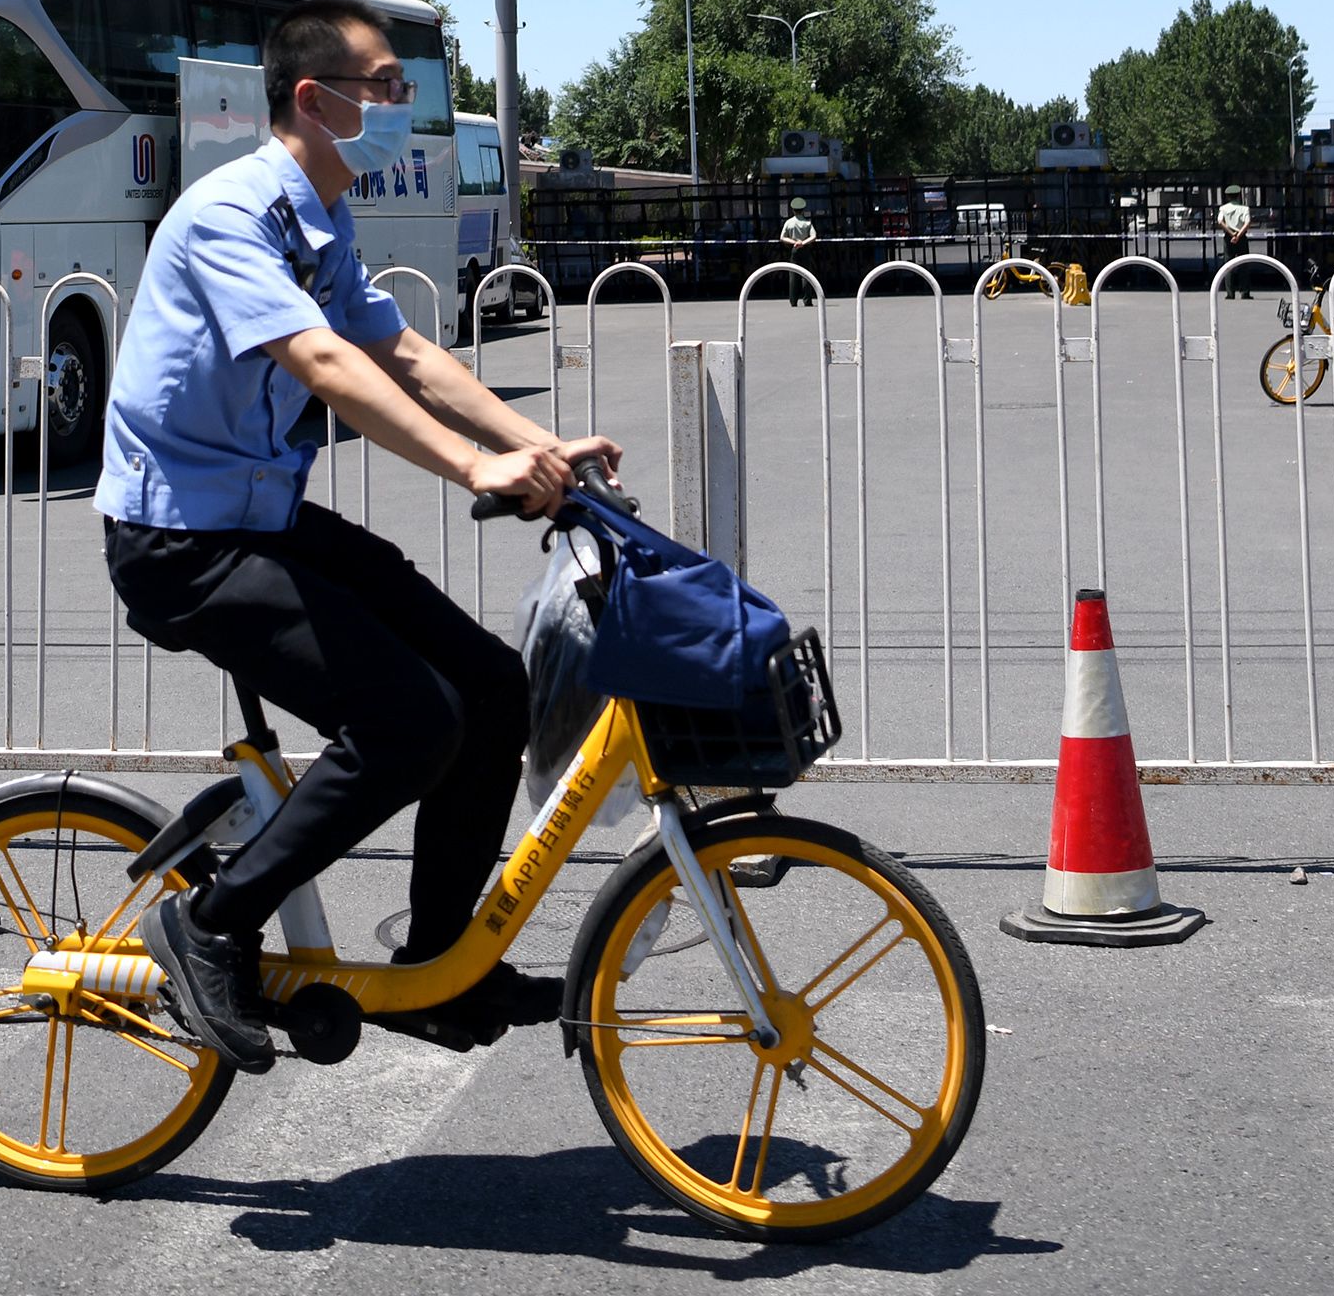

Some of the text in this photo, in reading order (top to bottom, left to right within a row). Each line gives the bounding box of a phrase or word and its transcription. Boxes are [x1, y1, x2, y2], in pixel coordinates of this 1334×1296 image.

[513, 849, 542, 894] APP
[537, 768, 596, 852] 扫码骑行
